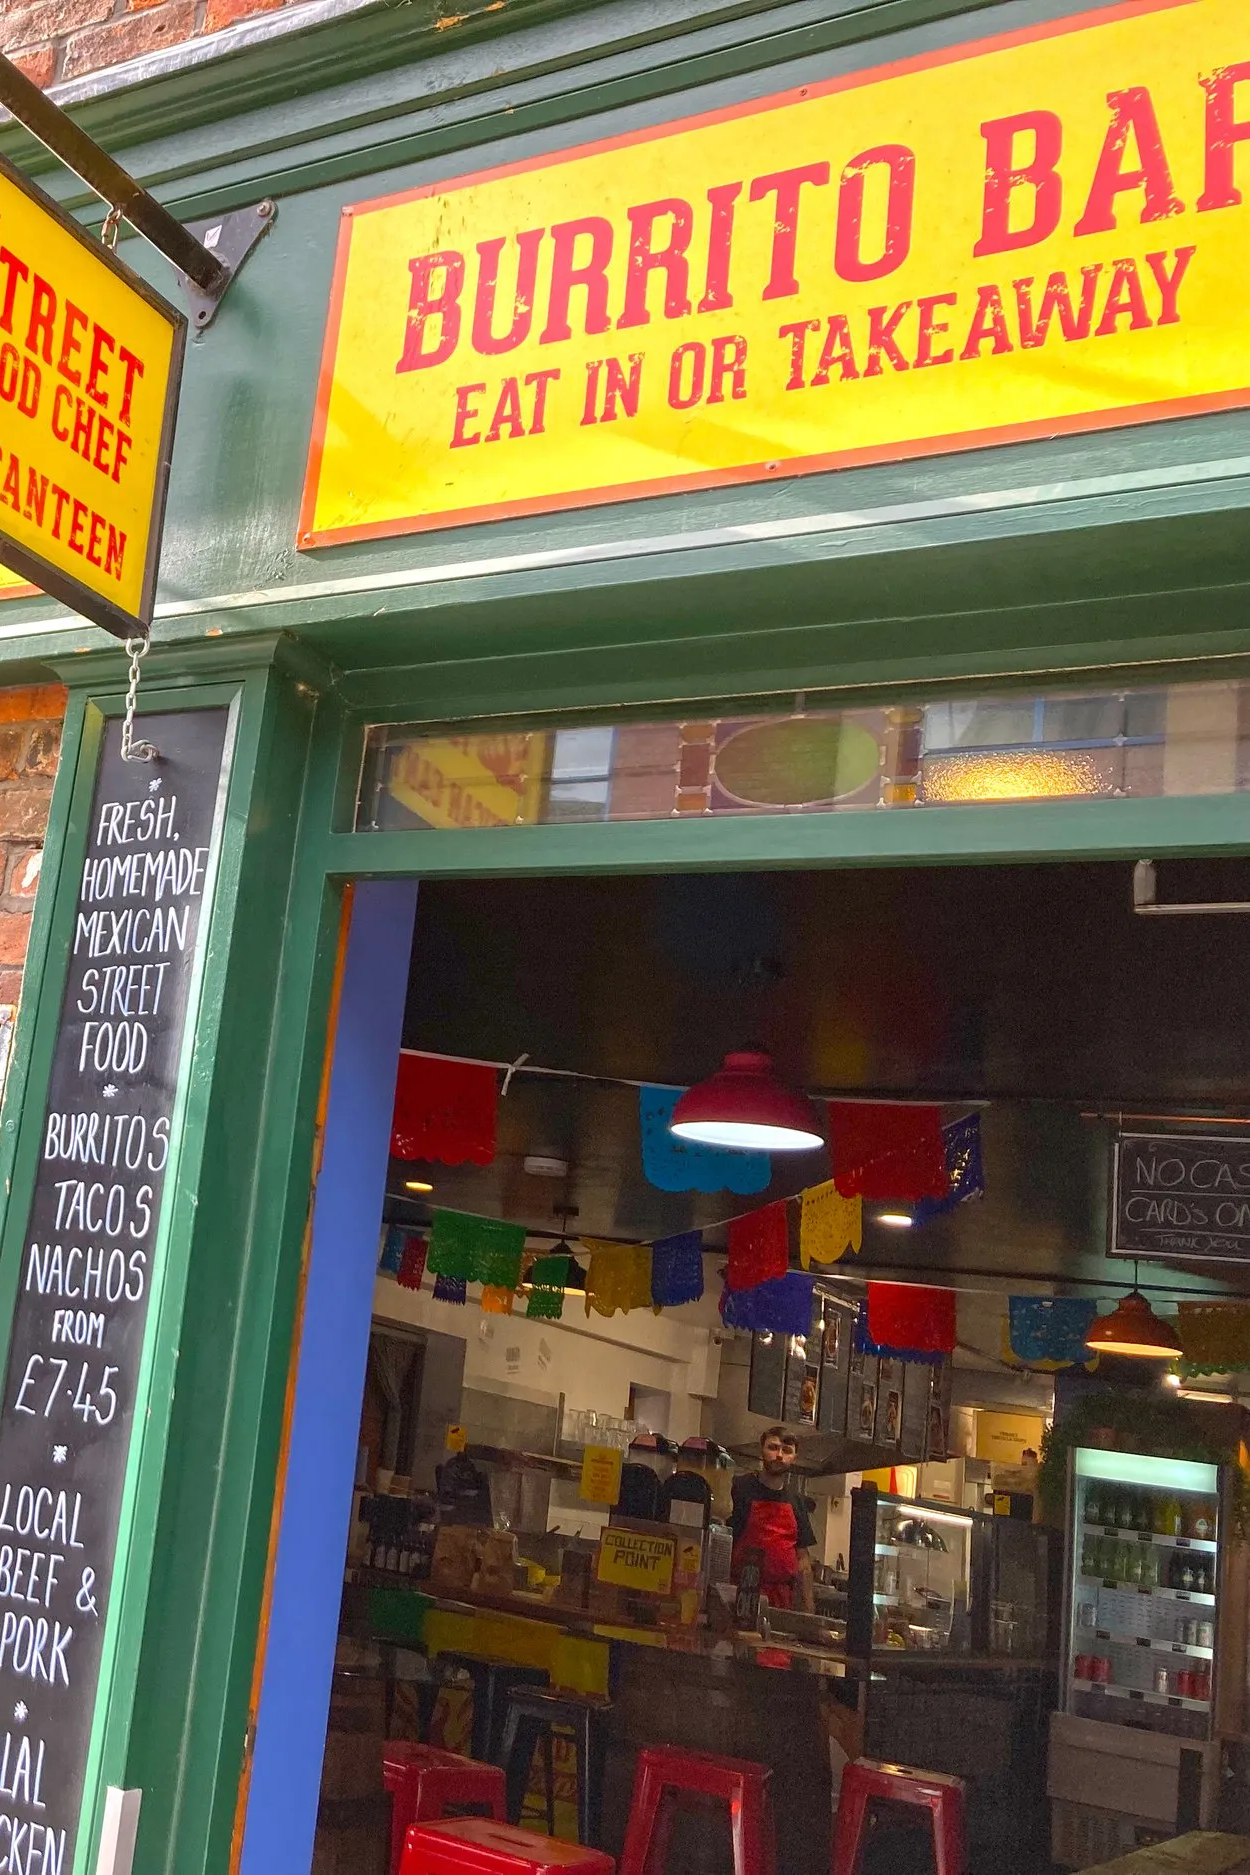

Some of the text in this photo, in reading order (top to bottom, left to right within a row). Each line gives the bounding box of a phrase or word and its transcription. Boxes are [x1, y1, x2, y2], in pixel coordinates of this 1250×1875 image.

[396, 143, 916, 374] BURRITO
[450, 246, 1197, 449] EAT IN OR TAKEAWAY
[50, 386, 133, 485] CHEF
[96, 795, 180, 846] FRESH,
[81, 847, 210, 902] HOMEMADE
[74, 905, 190, 958] MEXICAN
[77, 963, 171, 1017] STREET
[79, 1020, 148, 1074] FOOD
[44, 1111, 170, 1172] BURRITOS
[1136, 1156, 1186, 1187] NO
[54, 1179, 153, 1238] TACOS
[25, 1243, 147, 1302] NACHOS
[51, 1309, 105, 1349] FROM
[604, 1533, 672, 1557] COLLECTION
[613, 1550, 661, 1571] POINT
[75, 1566, 99, 1618] &
